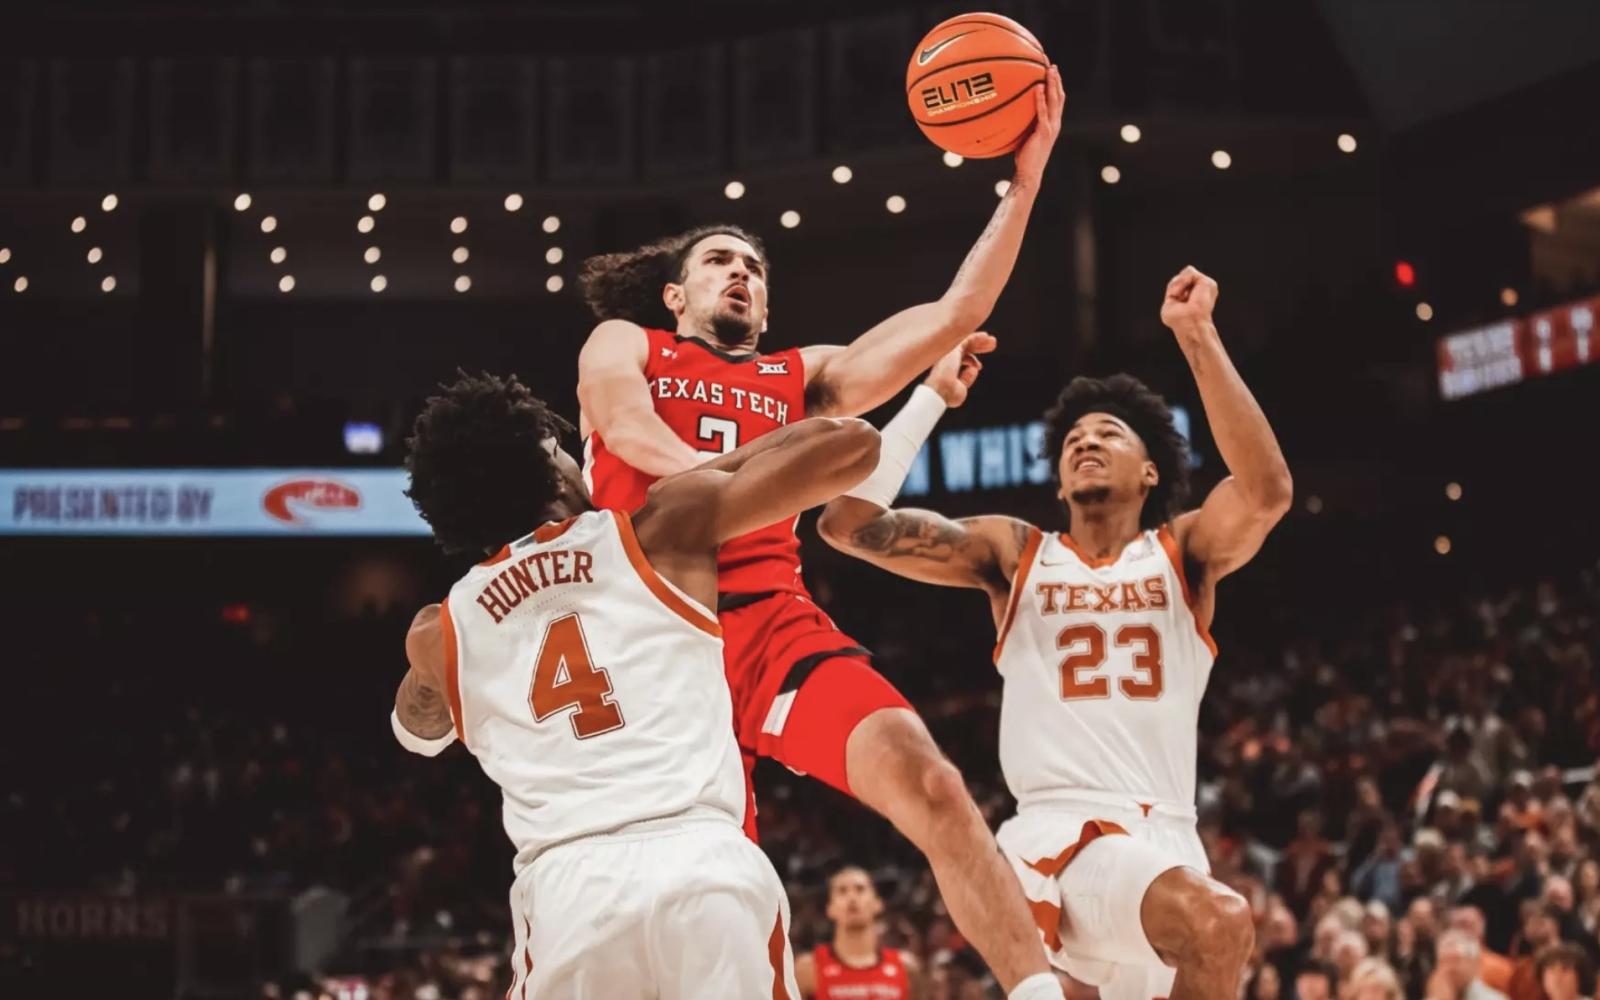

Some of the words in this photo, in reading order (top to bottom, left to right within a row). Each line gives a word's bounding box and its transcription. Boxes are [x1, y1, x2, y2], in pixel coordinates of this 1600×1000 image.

[921, 72, 995, 109] ELITE
[731, 387, 789, 426] TECH
[13, 486, 172, 522] PRESENTED
[177, 485, 213, 522] BY
[476, 550, 593, 624] HUNTER
[1036, 574, 1169, 616] TEXAS
[528, 612, 625, 740] 4
[1056, 622, 1165, 702] 23
